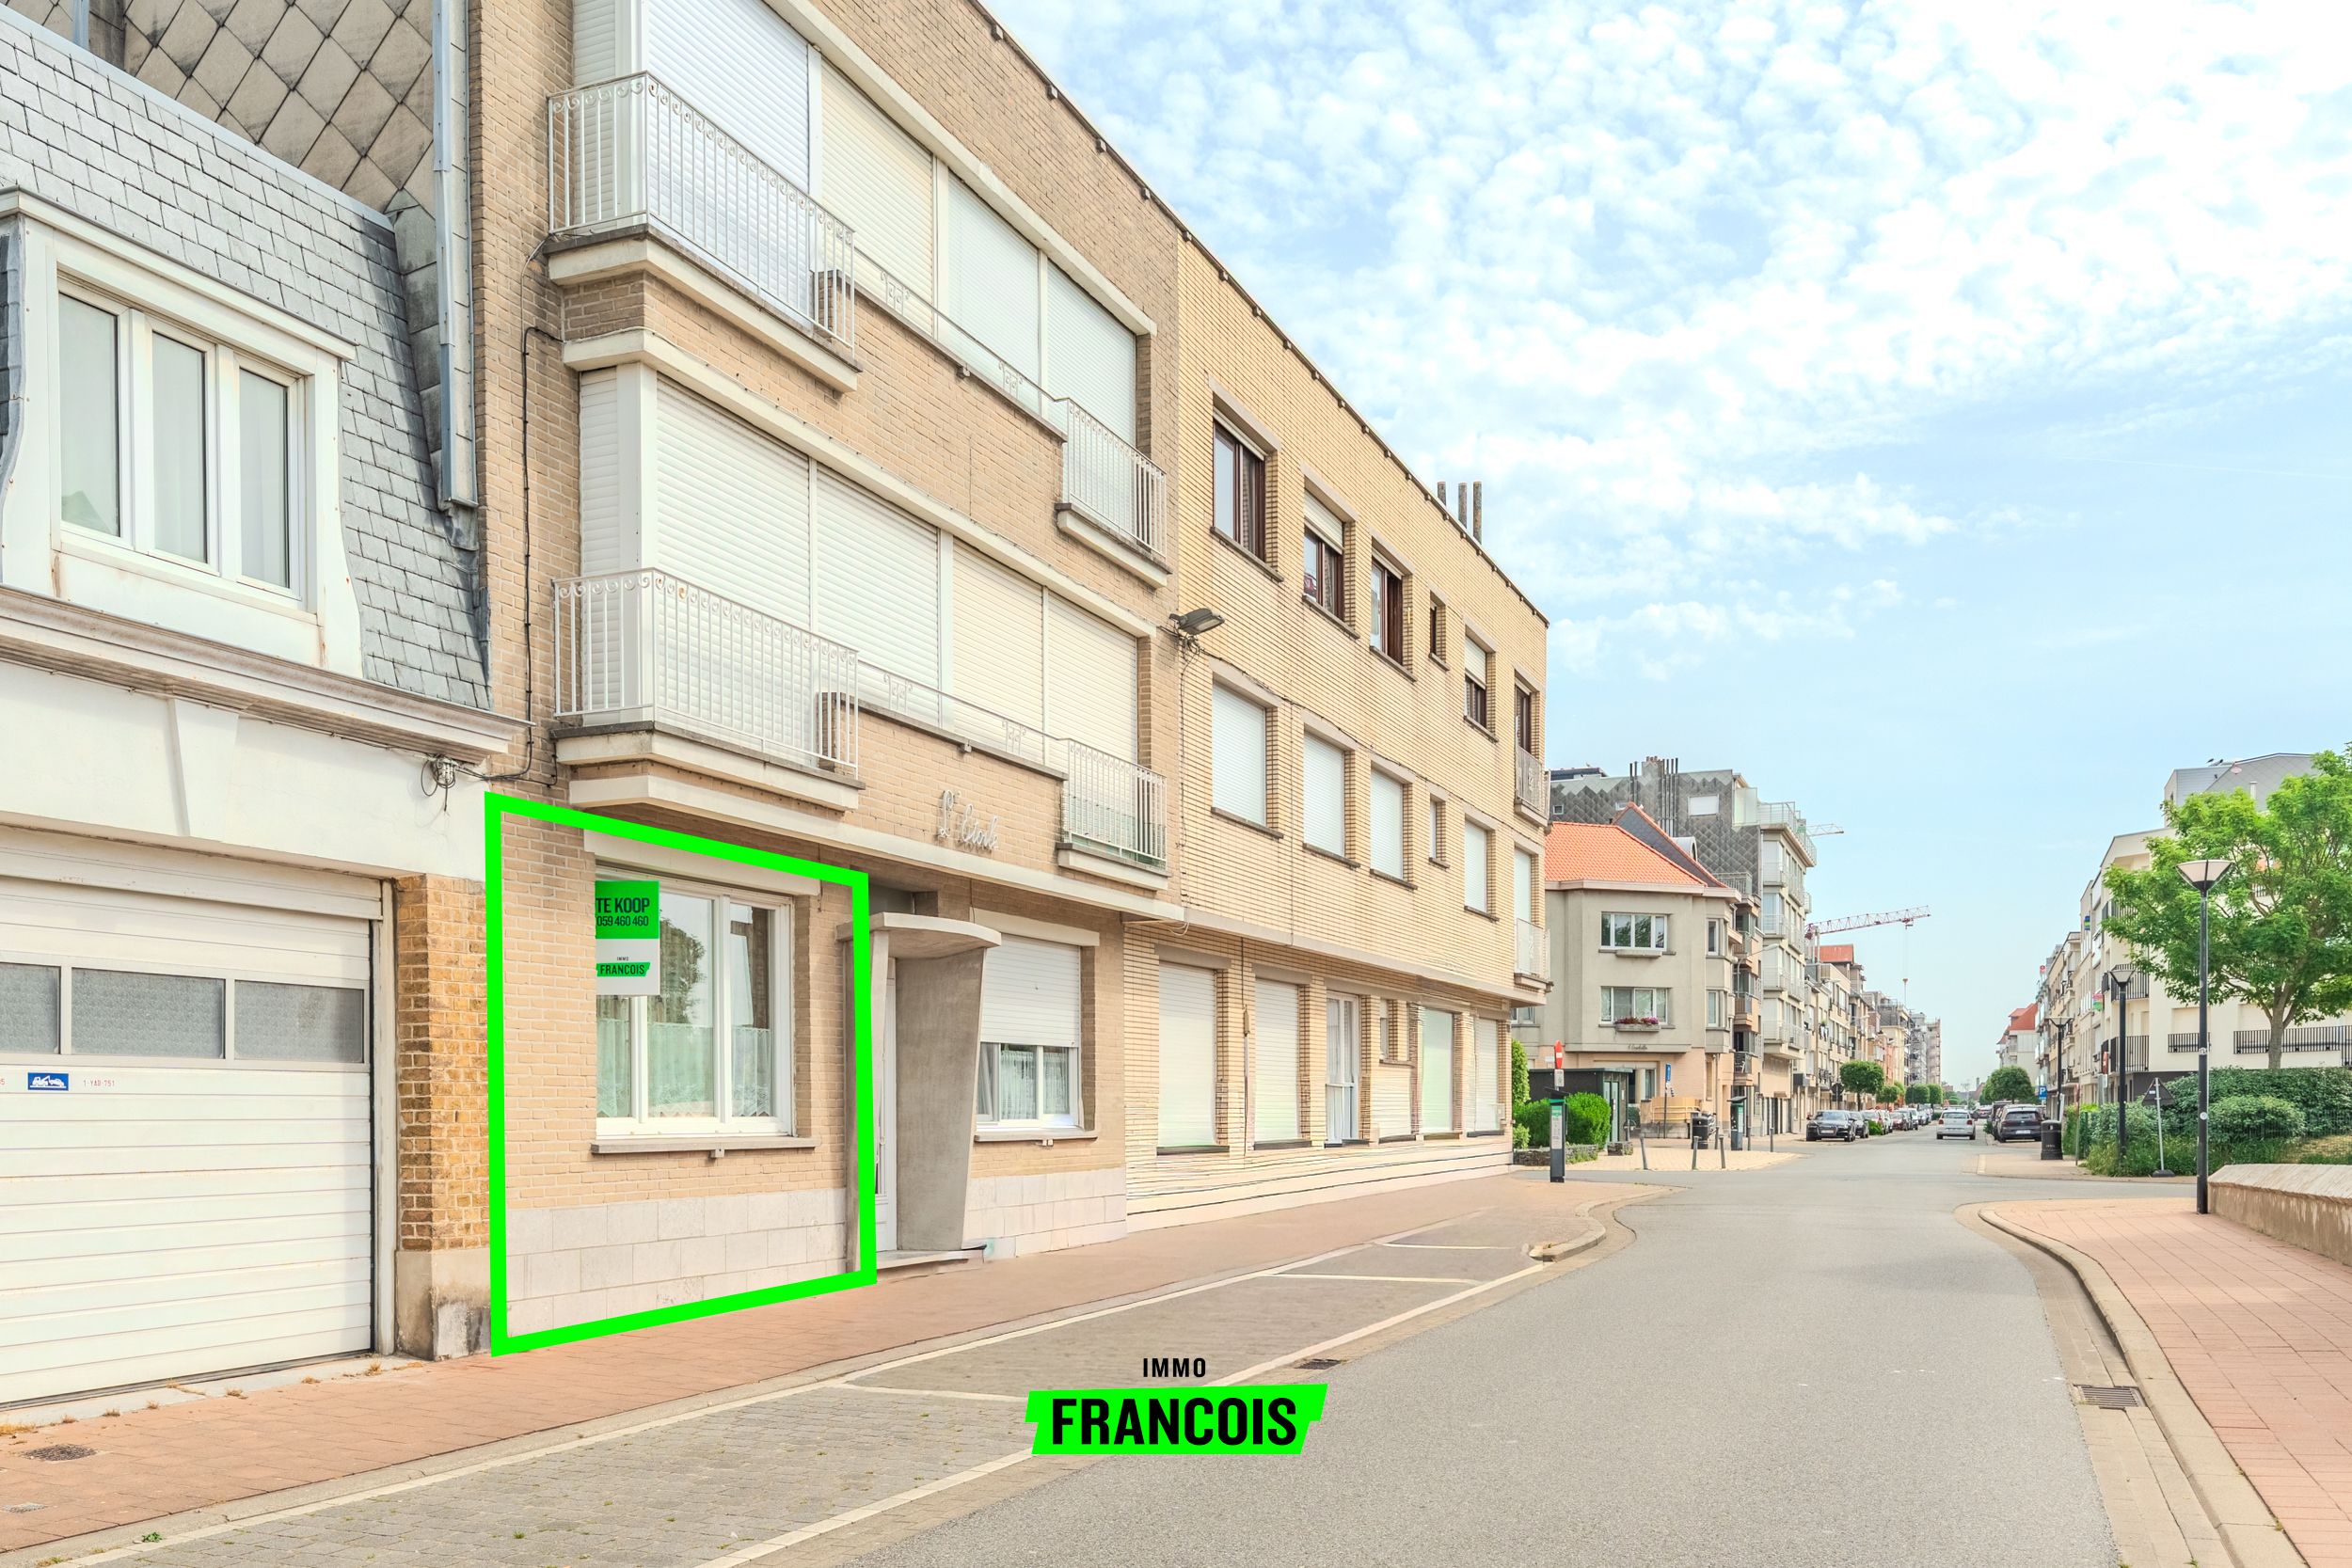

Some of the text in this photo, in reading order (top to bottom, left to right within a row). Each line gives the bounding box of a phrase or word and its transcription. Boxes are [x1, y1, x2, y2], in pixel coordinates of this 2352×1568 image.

[596, 897, 650, 913] TE KOOP
[596, 915, 649, 927] 059 460 460
[600, 964, 645, 975] FRANCOIS
[2039, 1086, 2046, 1096] P
